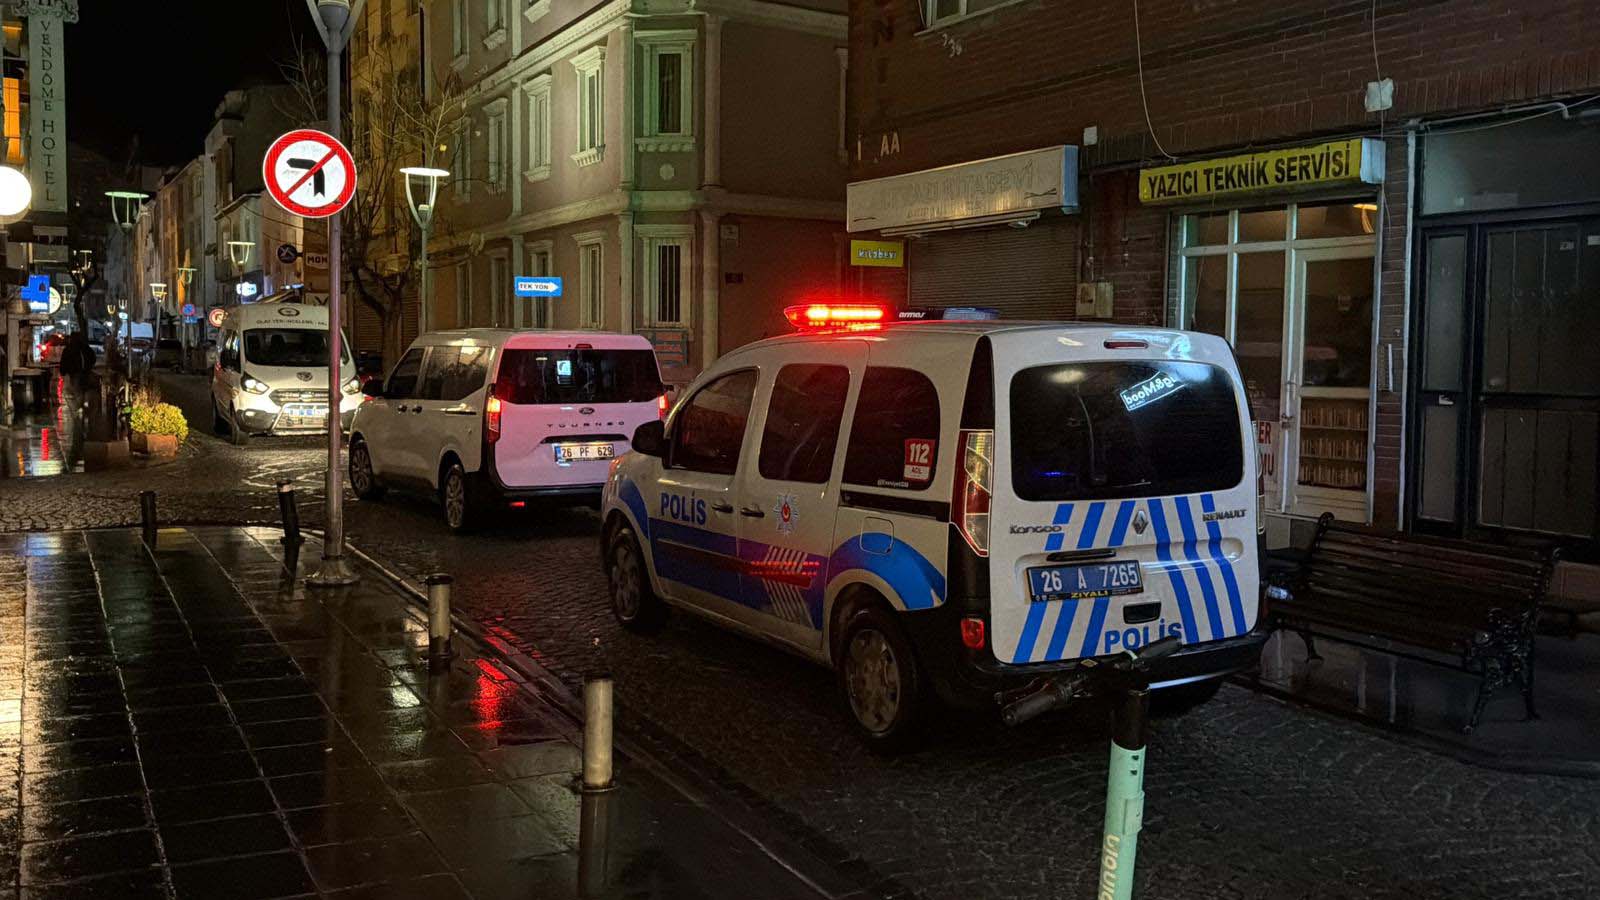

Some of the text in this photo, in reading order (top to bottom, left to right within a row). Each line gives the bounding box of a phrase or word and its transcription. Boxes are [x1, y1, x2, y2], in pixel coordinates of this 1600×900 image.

[41, 20, 56, 201] VENDOME HOTEL
[1148, 143, 1350, 199] YAZICI TEKNİK SERVİSİ
[561, 446, 613, 458] 26 PF 629
[910, 443, 930, 464] 112
[660, 491, 707, 526] POLİS
[1202, 508, 1247, 522] RENAULT
[1009, 524, 1062, 534] Kangoo
[1040, 563, 1139, 592] 26 A 7265
[1104, 618, 1183, 654] POLİS
